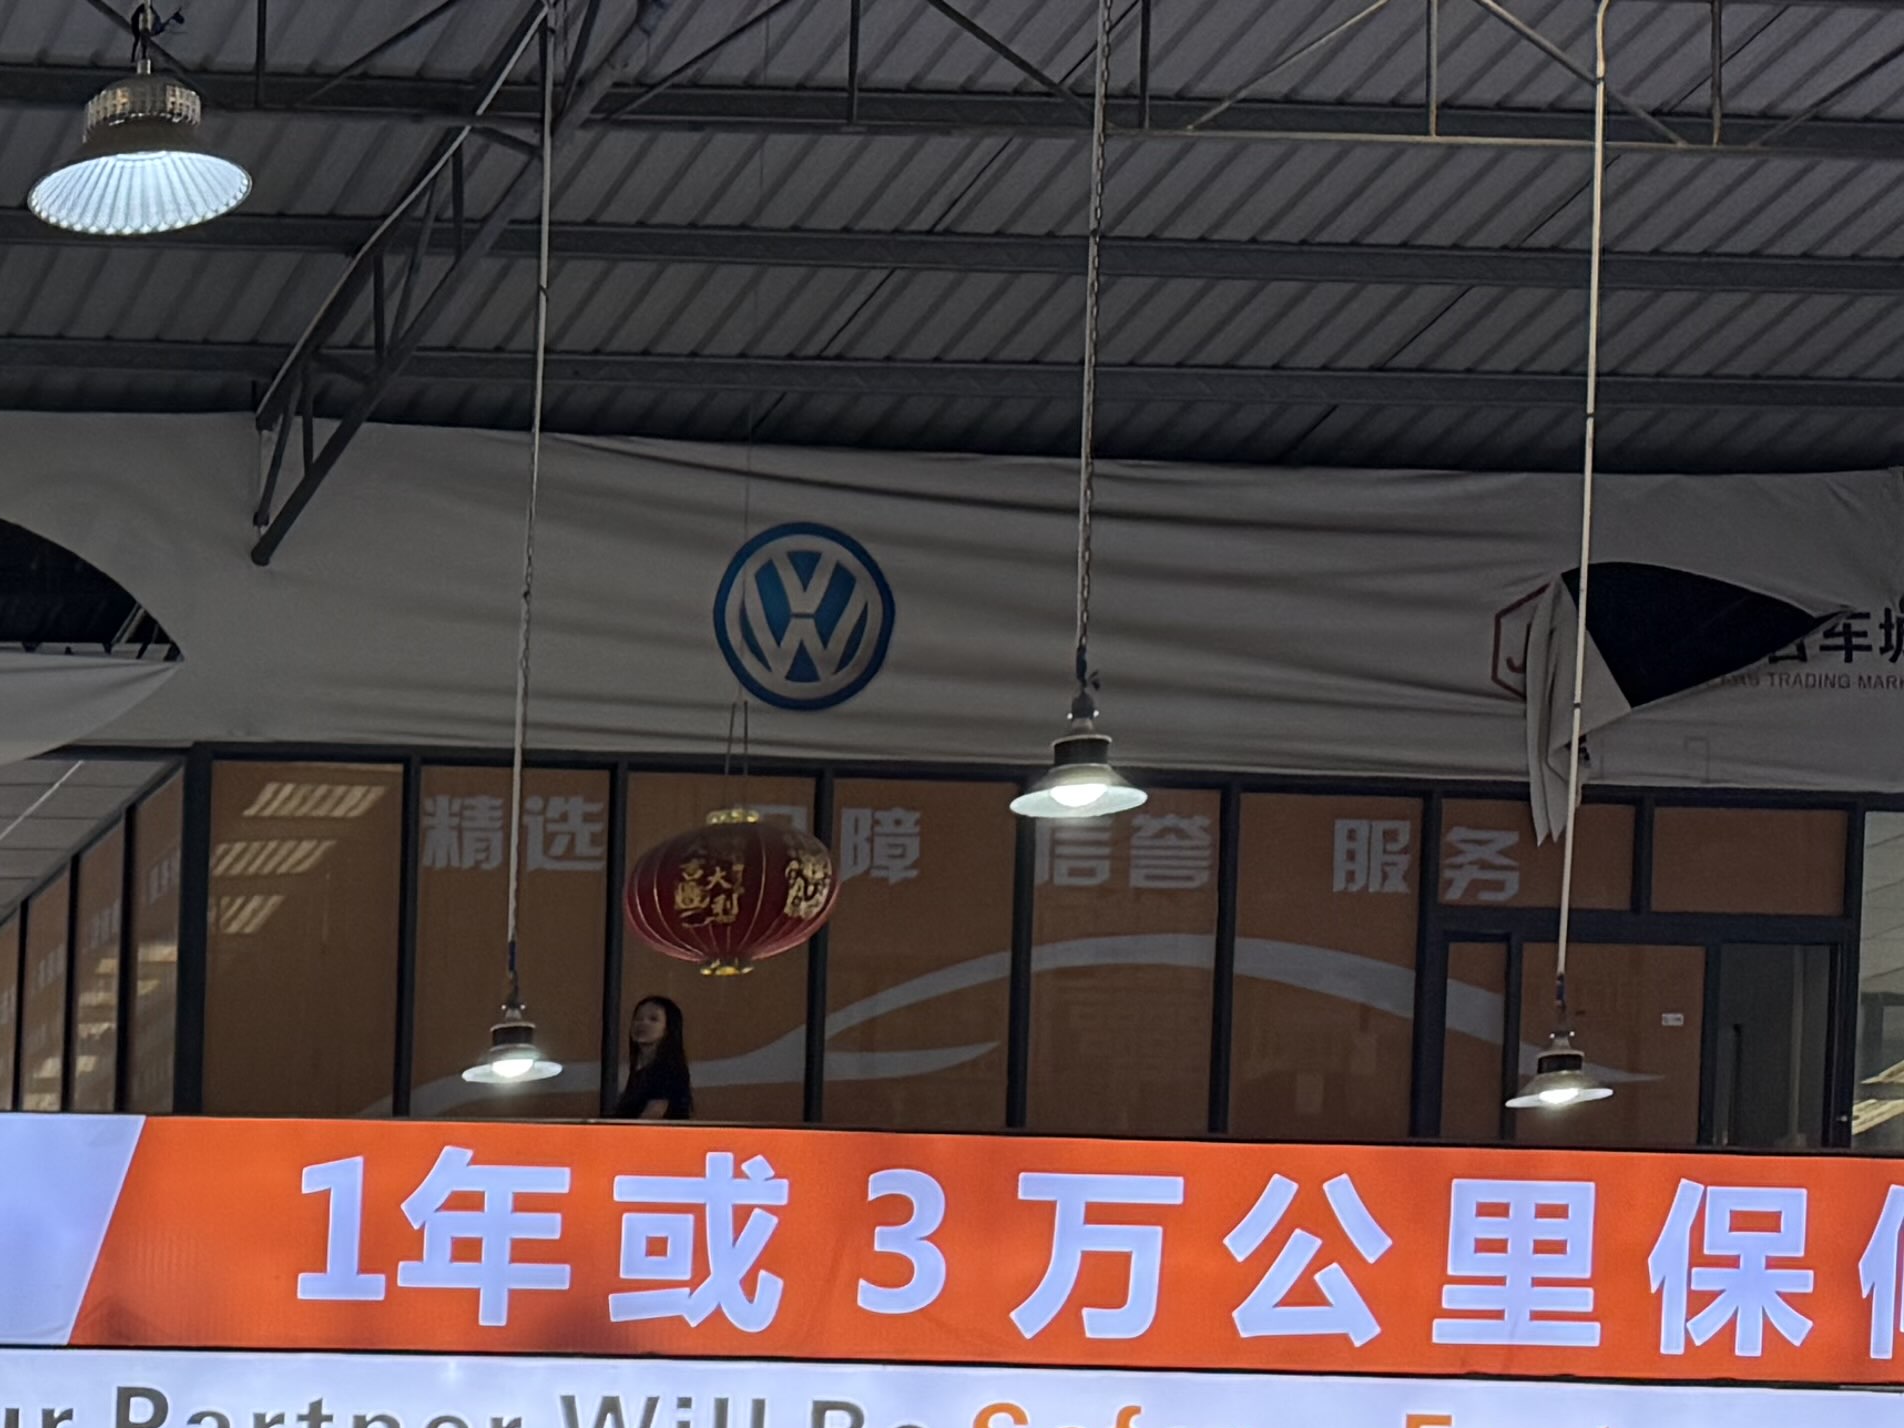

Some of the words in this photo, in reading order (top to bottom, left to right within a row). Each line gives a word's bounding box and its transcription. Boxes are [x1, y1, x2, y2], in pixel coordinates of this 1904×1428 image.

[1768, 672, 1851, 690] TRADING
[423, 795, 604, 873] 精选
[1332, 819, 1521, 903] 服务
